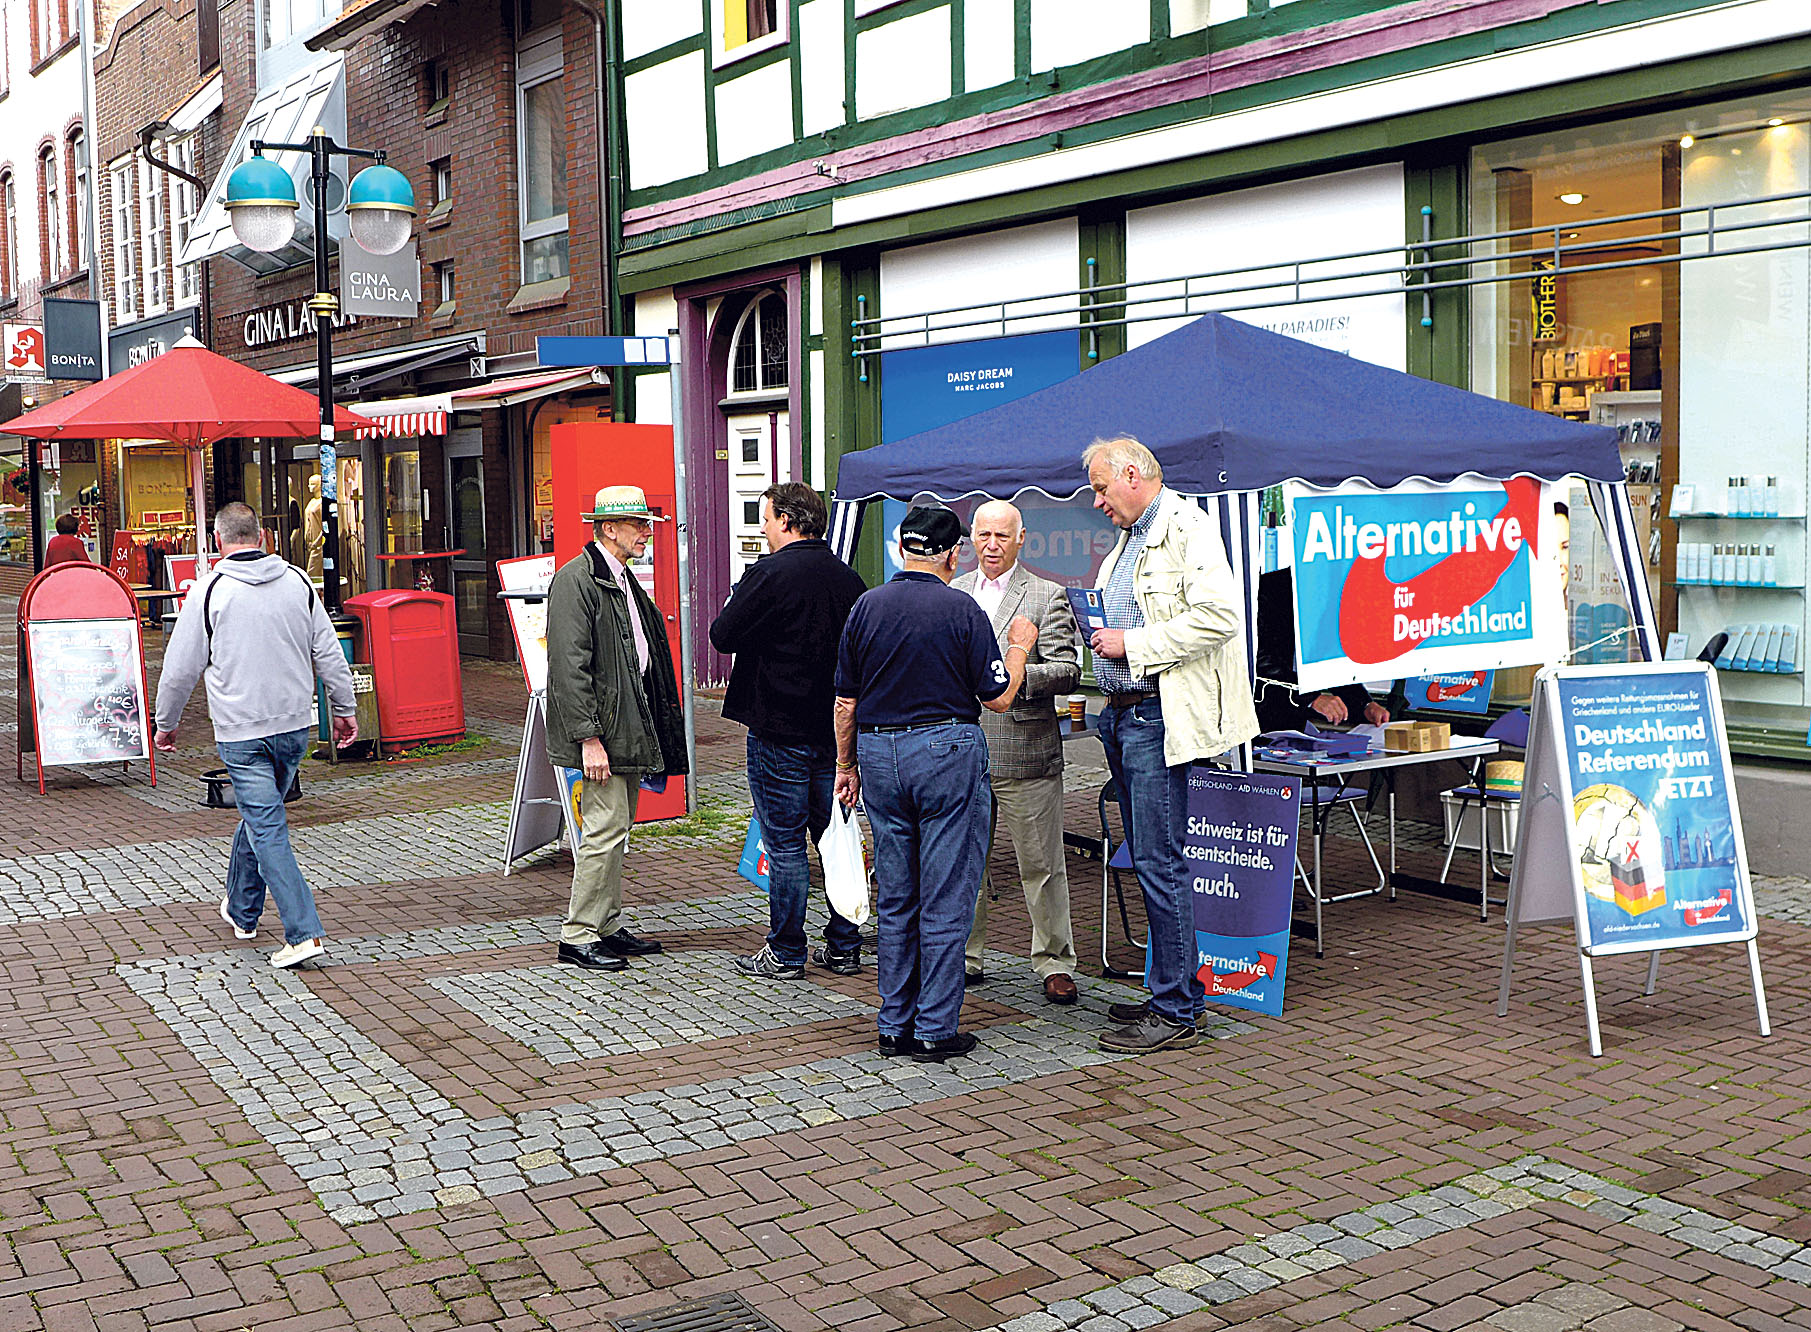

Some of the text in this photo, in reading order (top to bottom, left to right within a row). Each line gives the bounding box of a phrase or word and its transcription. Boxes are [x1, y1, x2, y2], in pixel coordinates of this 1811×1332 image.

[350, 271, 391, 287] GINA
[351, 285, 413, 302] LAURA
[243, 307, 287, 347] GINA
[1280, 315, 1351, 335] PARADIES!
[51, 353, 96, 368] BONITA
[947, 367, 1013, 383] DAISY DREAM
[954, 381, 1005, 392] MARC JACOBS
[1630, 494, 1648, 506] SUN
[1301, 501, 1523, 564] Alternative
[116, 547, 128, 561] SA
[116, 566, 129, 580] 50
[1393, 586, 1416, 609] für
[1600, 586, 1621, 597] SEKU
[1393, 601, 1527, 642] Deutschland
[991, 659, 1008, 684] 3
[1571, 695, 1595, 707] Gegen
[1596, 695, 1620, 704] weitere
[1689, 690, 1699, 699] für
[1572, 706, 1618, 717] Griechenland
[1619, 704, 1632, 714] und
[1632, 704, 1656, 714] andere
[1574, 716, 1706, 746] Deutschland
[1577, 745, 1710, 774] Referendum
[1188, 778, 1233, 790] DEUTSCHLAND
[1251, 785, 1280, 796] WÄHLEN
[1187, 816, 1290, 847] Schweiz ist für
[1182, 845, 1274, 871] ksentscheide.
[1192, 873, 1240, 900] auch.
[1672, 895, 1728, 911] Alternative
[1198, 950, 1267, 977] ternative
[1212, 983, 1265, 1002] Deutschland
